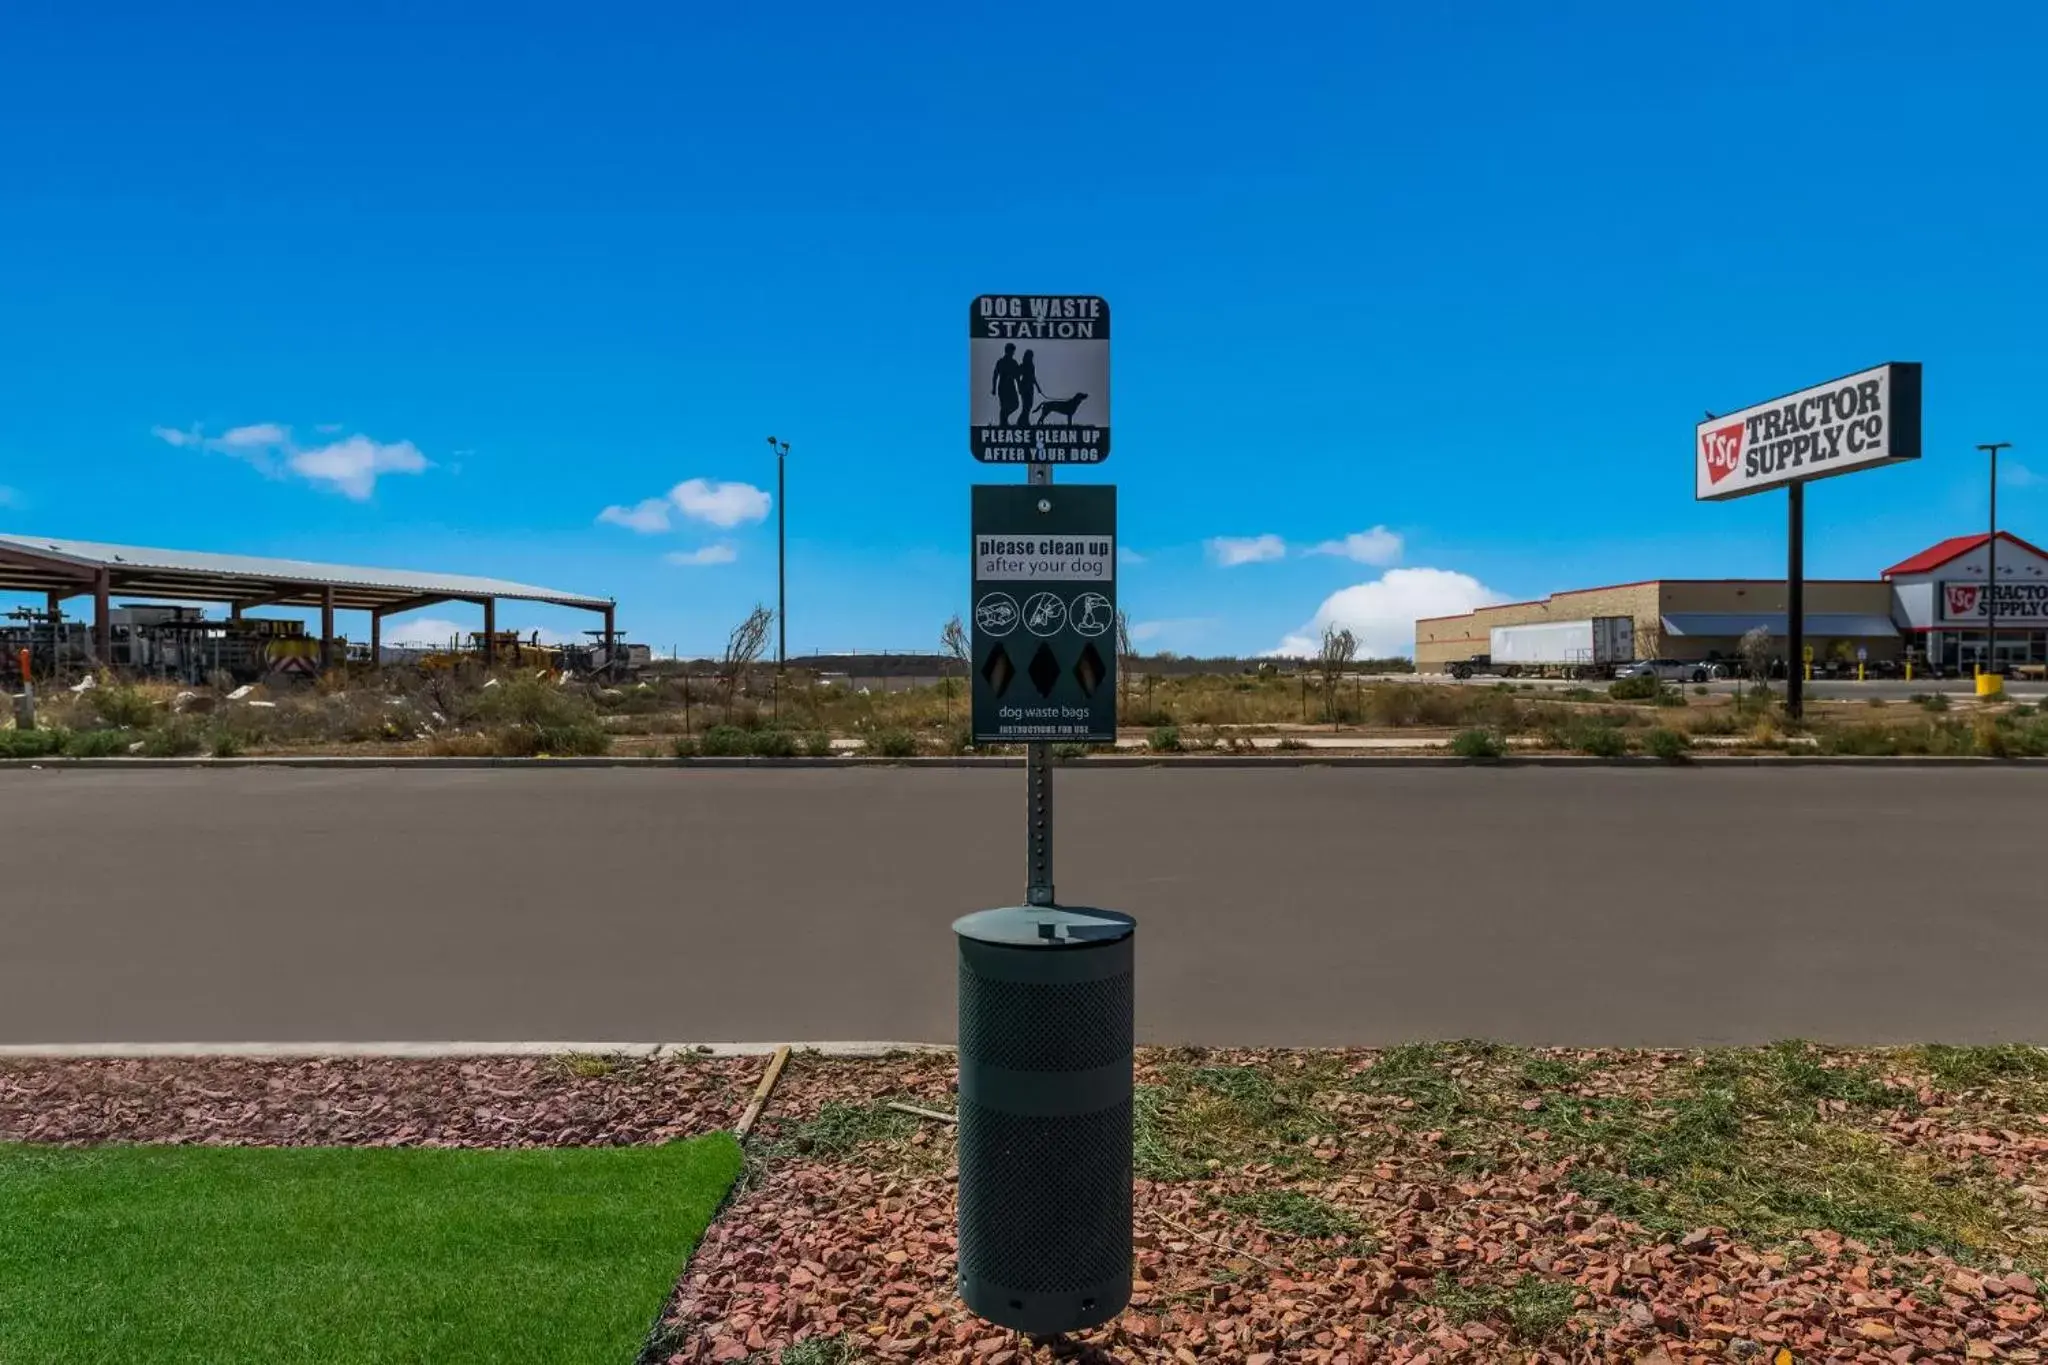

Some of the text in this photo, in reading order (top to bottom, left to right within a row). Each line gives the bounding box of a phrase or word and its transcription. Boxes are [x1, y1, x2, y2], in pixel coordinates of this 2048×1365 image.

[980, 297, 1100, 318] DOG WASTE
[987, 321, 1093, 338] STATION
[1746, 379, 1881, 446] TRACTOR
[981, 429, 1100, 444] PLEASE CLEAN UP
[984, 447, 1099, 461] AFTER YOUR DOG
[1705, 432, 1737, 470] TSC
[1745, 424, 1844, 479] SUPPLY
[980, 539, 1108, 557] please clean up
[986, 557, 1103, 577] after your dog
[999, 704, 1090, 720] dog waste bags
